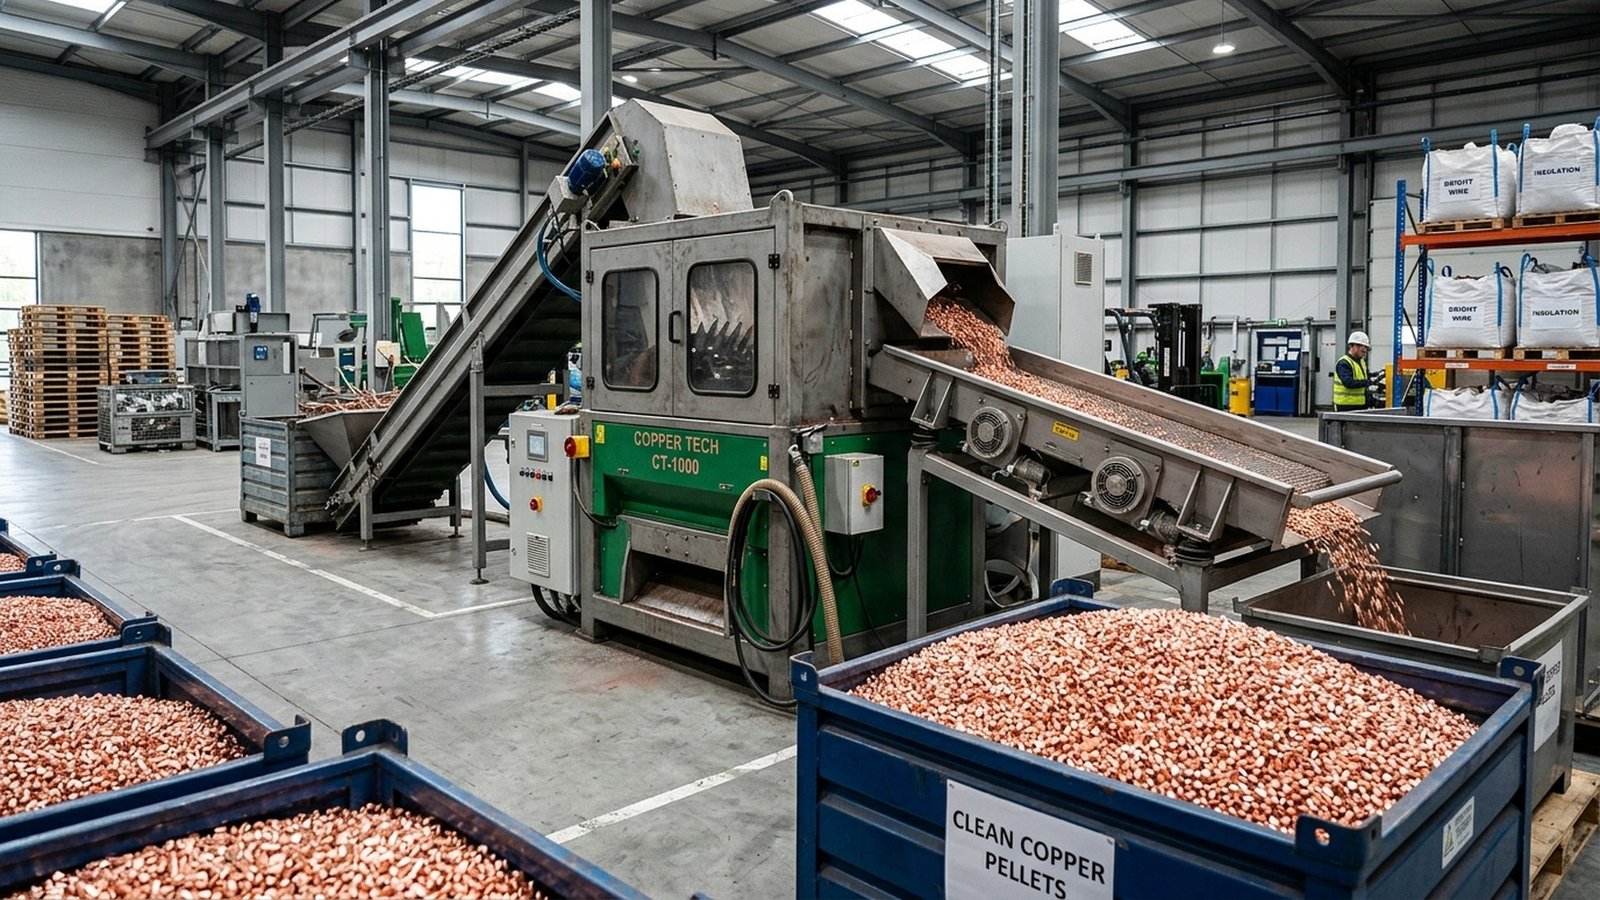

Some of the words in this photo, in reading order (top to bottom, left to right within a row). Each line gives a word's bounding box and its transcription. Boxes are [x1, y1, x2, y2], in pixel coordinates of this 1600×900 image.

[633, 430, 682, 451] COPPER
[685, 436, 719, 455] TECH
[651, 454, 700, 475] CT-1000
[952, 809, 1014, 849] CLEAN
[1020, 836, 1106, 885] COPPER
[985, 851, 1067, 900] PELLETS
